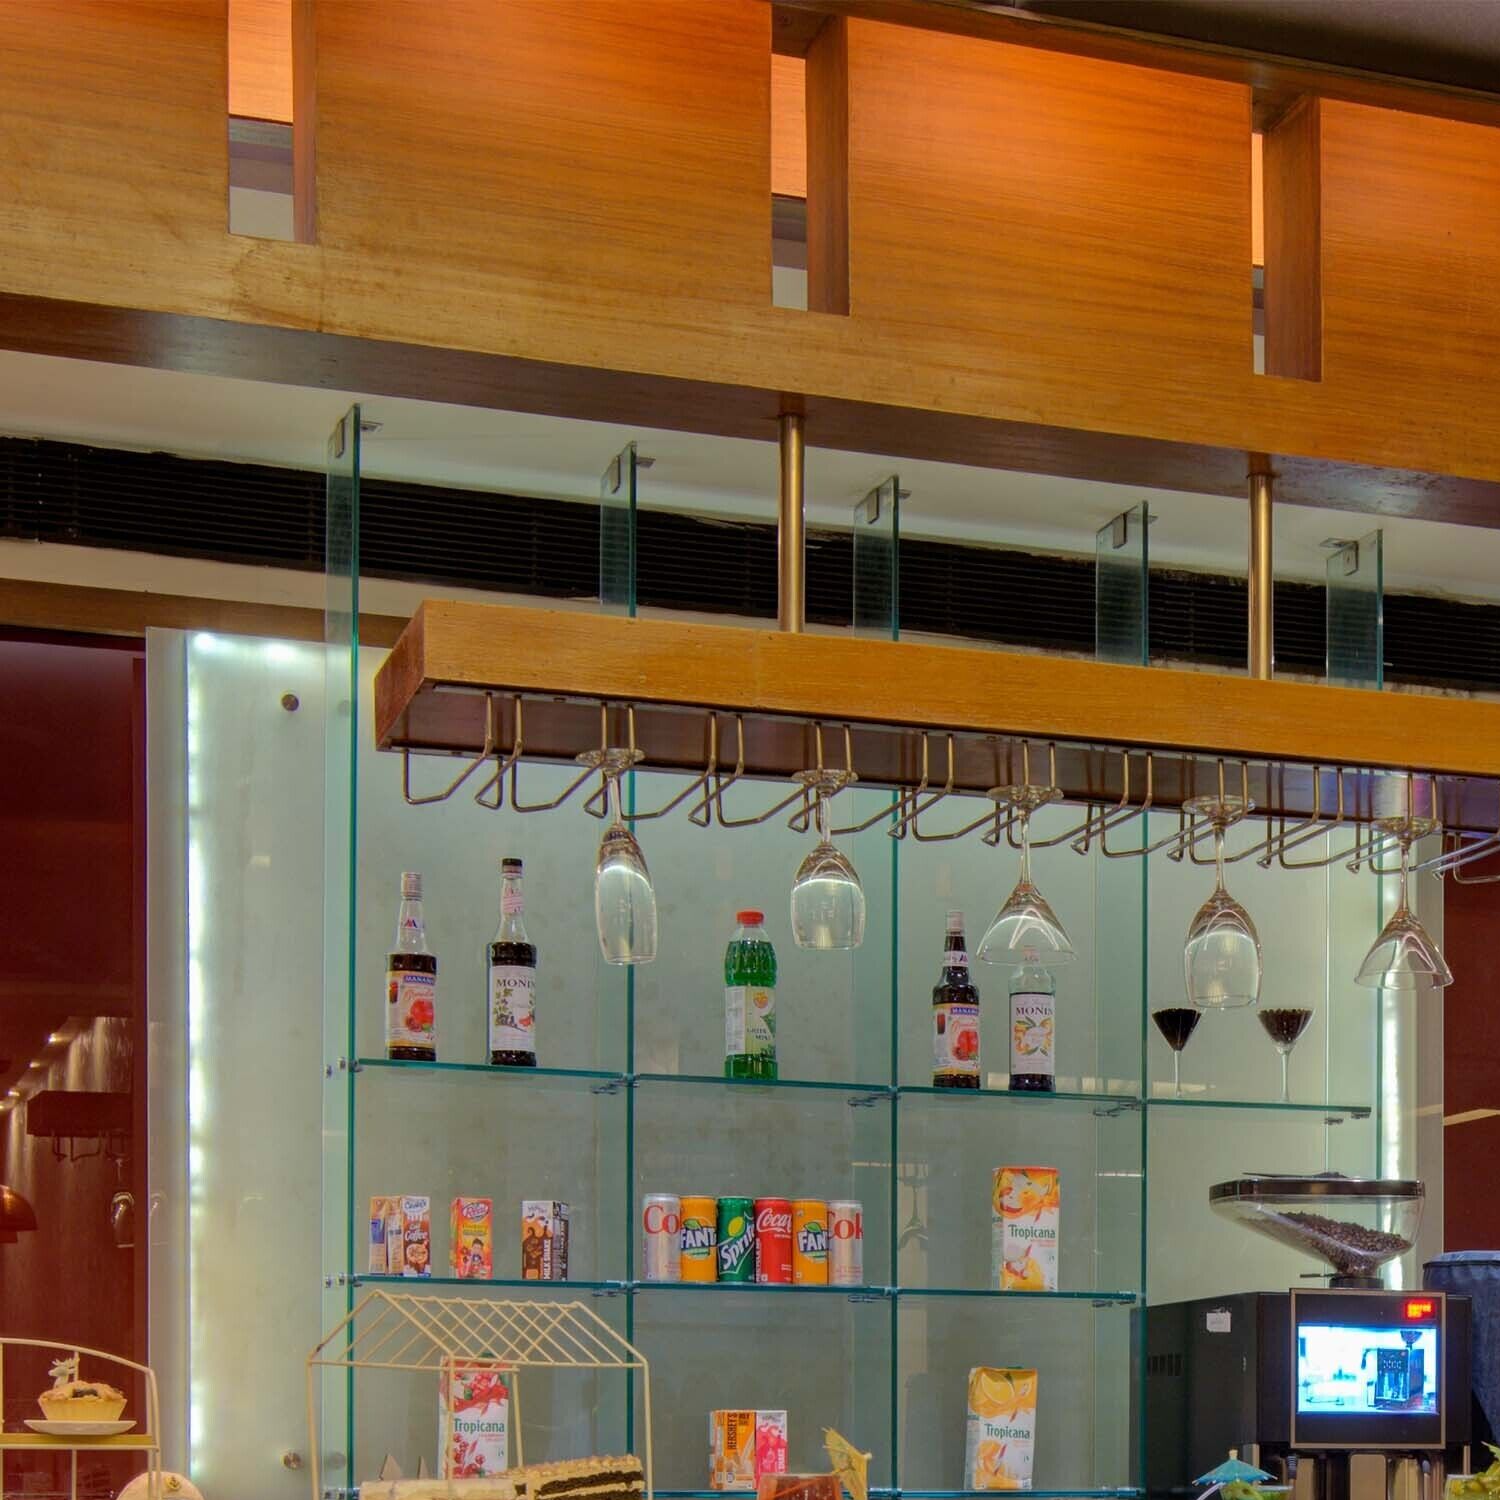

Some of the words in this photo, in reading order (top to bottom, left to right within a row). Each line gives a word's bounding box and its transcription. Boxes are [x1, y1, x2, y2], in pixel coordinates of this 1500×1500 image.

[1008, 1223, 1056, 1240] Tropicana
[543, 1262, 551, 1280] MILK
[454, 1418, 505, 1434] Tropicana
[984, 1423, 1031, 1440] Tropicana
